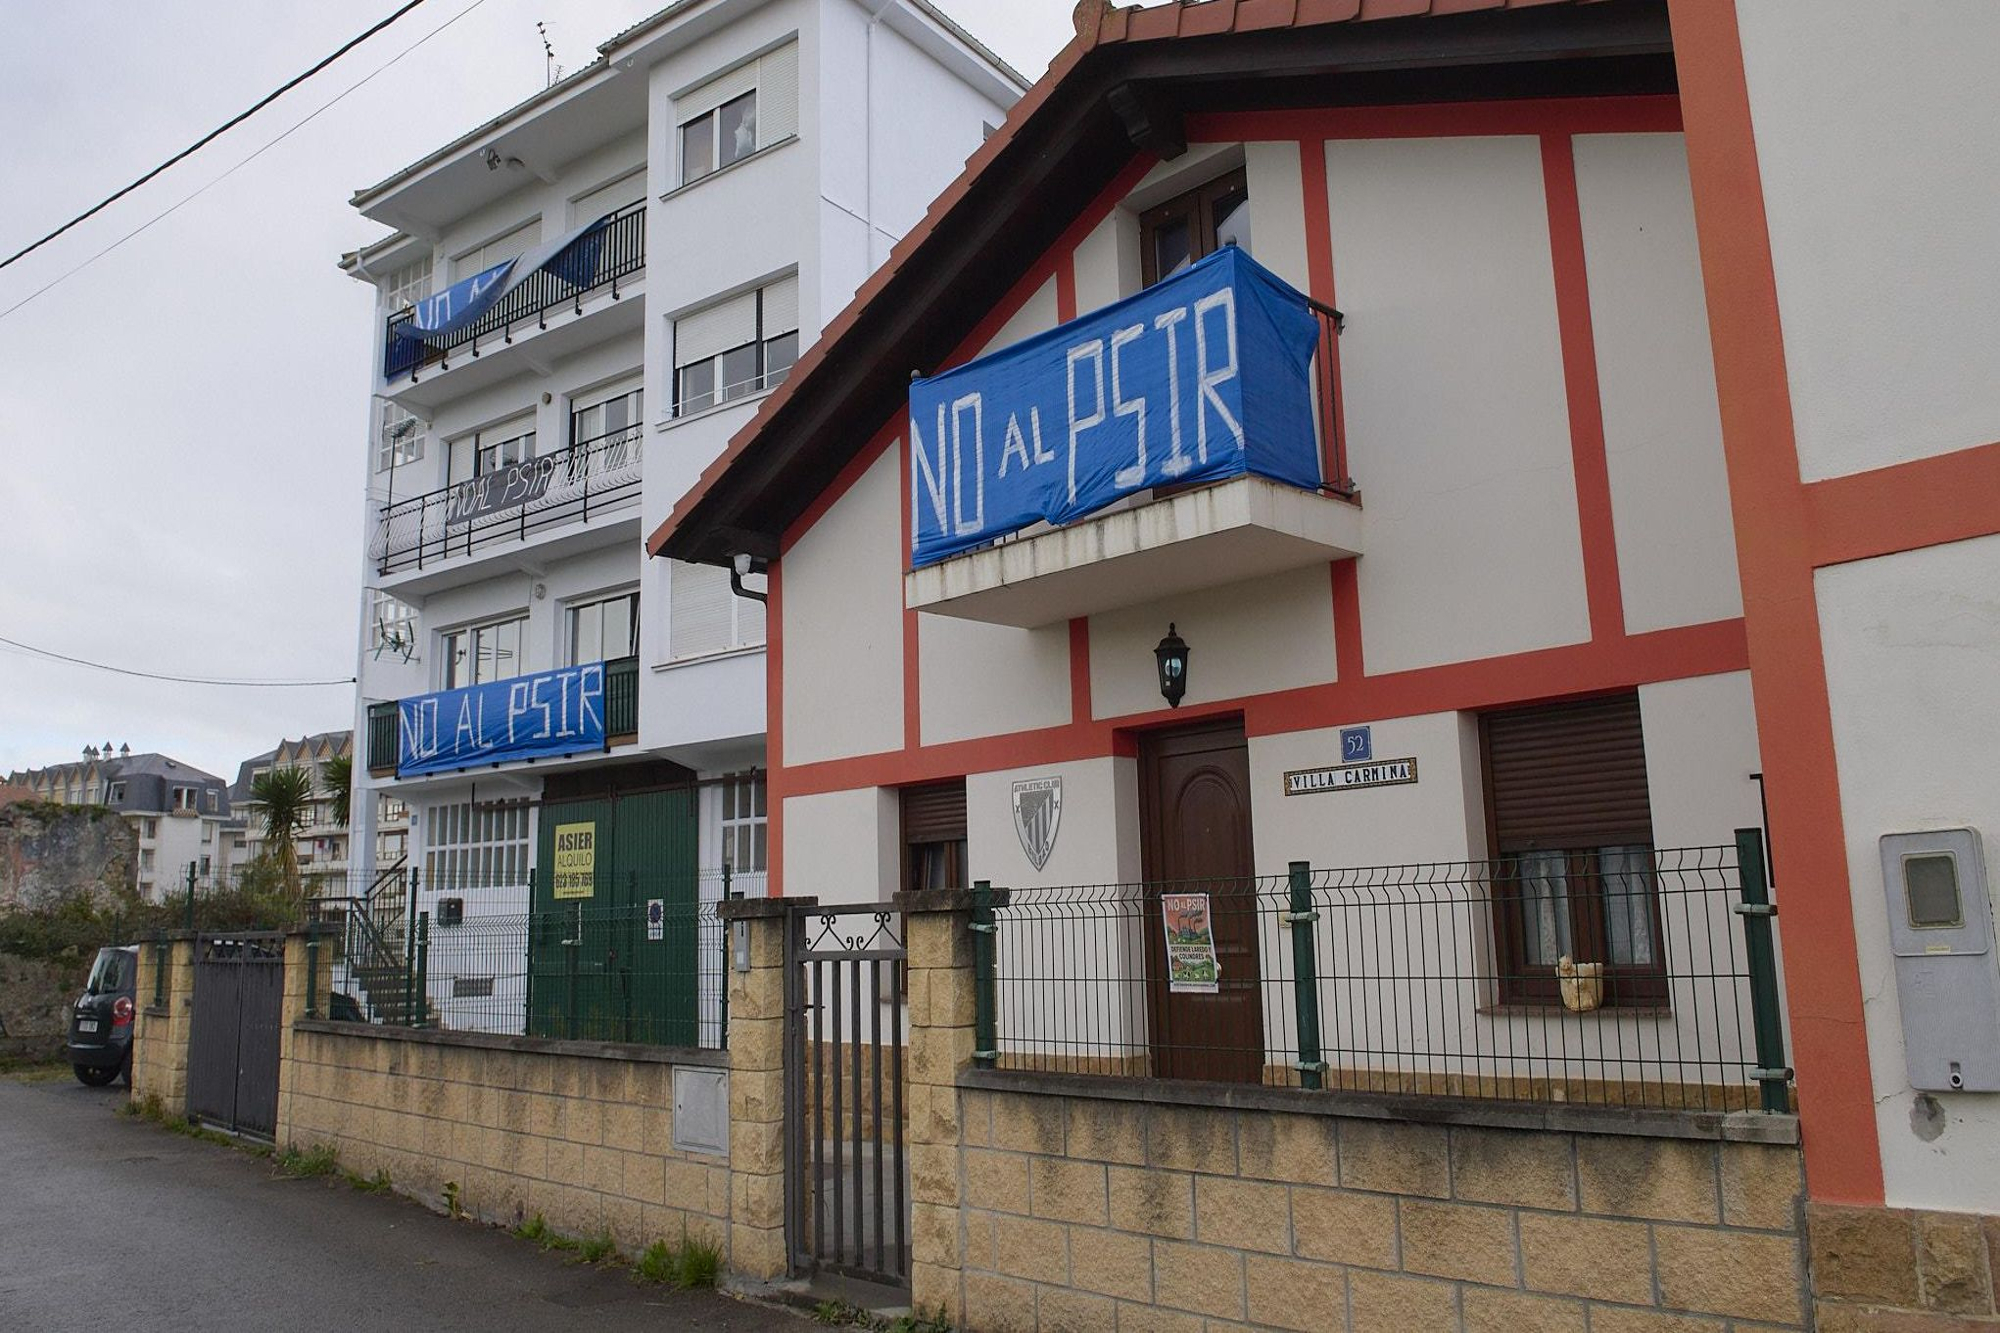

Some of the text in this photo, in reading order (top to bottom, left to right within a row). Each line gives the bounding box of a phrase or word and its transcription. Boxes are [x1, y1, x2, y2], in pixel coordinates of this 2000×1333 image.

[911, 287, 1245, 551] NO AL PSIR
[501, 457, 554, 504] PSIR
[400, 664, 602, 764] NO AL PSIR
[1347, 734, 1364, 755] 52
[1293, 764, 1408, 790] VILLA CARMINA
[558, 832, 592, 852] ASIER
[557, 852, 592, 868] ALQUILO
[1167, 899, 1180, 911] NO
[1187, 898, 1206, 911] PSIR
